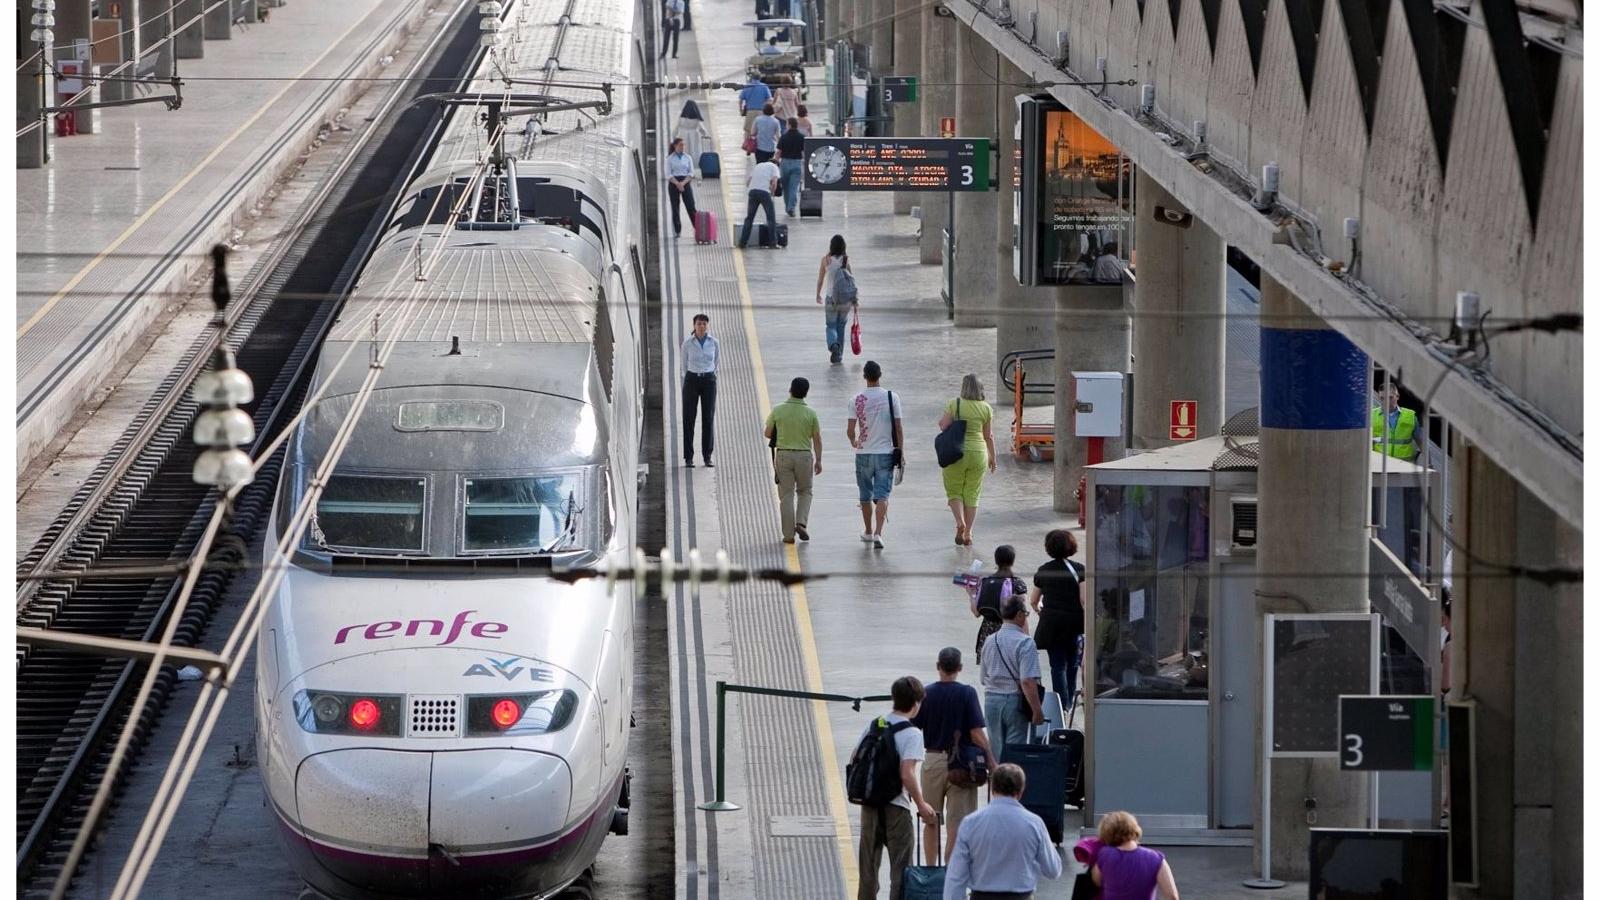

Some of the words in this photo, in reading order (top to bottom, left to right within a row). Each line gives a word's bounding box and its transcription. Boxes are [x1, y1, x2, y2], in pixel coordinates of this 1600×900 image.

[885, 89, 893, 102] 3
[960, 165, 974, 185] 3
[1053, 214, 1085, 222] Seguimos
[1053, 223, 1075, 231] pronto
[334, 610, 509, 646] renfe
[462, 658, 554, 683] AVE
[1344, 733, 1363, 767] 3
